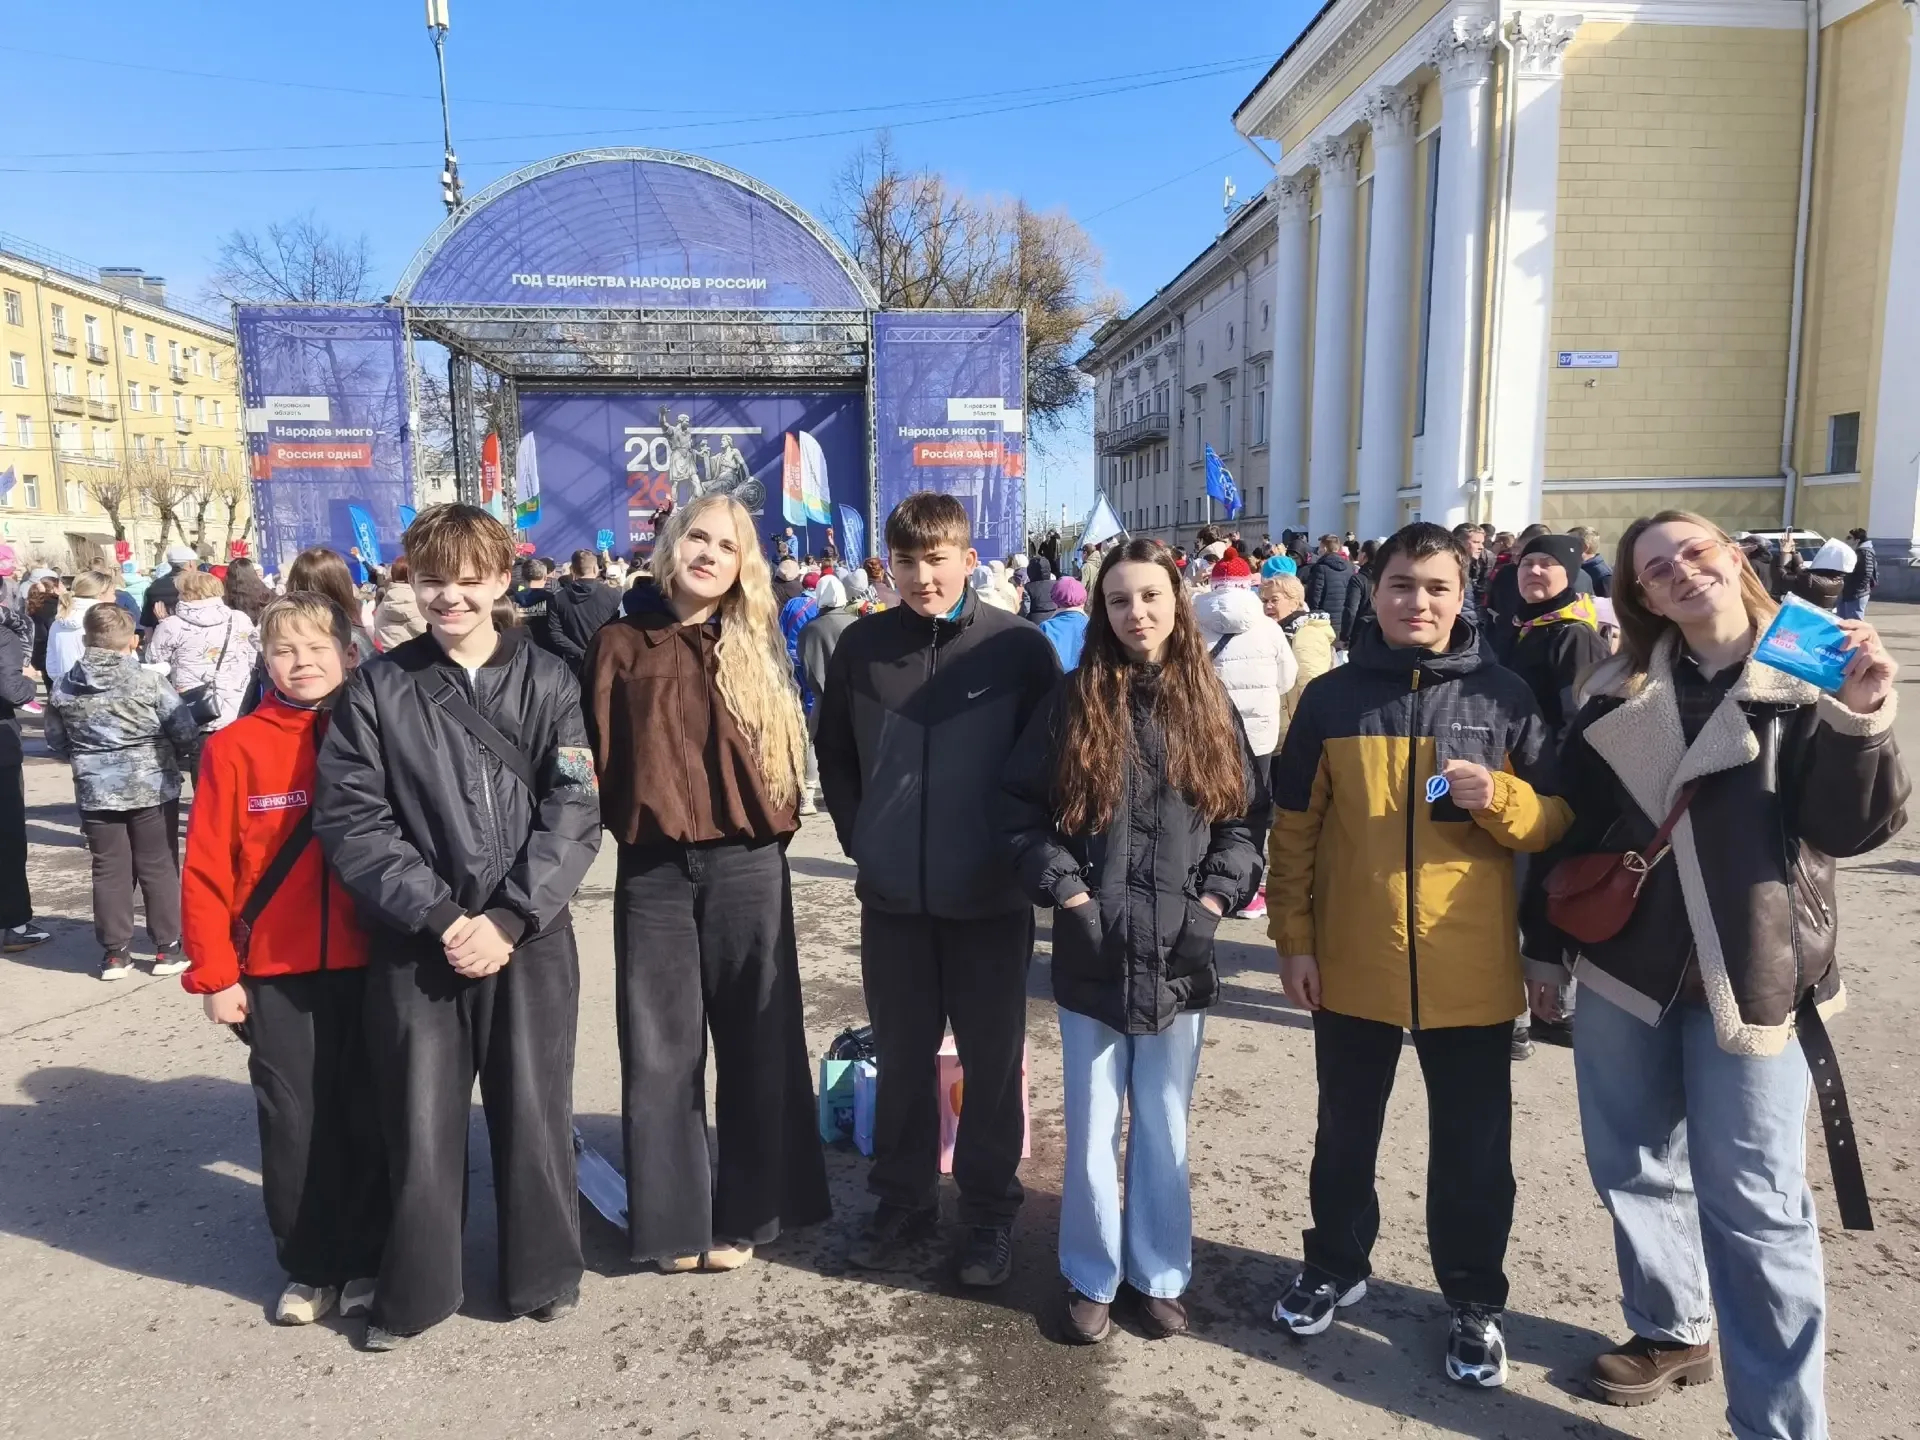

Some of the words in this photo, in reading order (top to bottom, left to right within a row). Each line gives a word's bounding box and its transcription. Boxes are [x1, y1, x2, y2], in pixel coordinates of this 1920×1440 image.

[512, 274, 542, 287] ГОД
[547, 275, 626, 288] ЕДИНСТВА
[630, 276, 701, 290] НАРОДОВ
[705, 278, 767, 289] РОССИИ
[1560, 355, 1571, 364] 37
[275, 426, 332, 438] Народов
[335, 427, 374, 437] много
[898, 426, 950, 438] Народов
[952, 427, 987, 437] много
[277, 448, 325, 459] Россия
[327, 448, 363, 460] одна!
[624, 436, 671, 472] 20
[921, 448, 964, 459] Россия
[966, 448, 998, 460] одна!
[627, 472, 673, 509] 26
